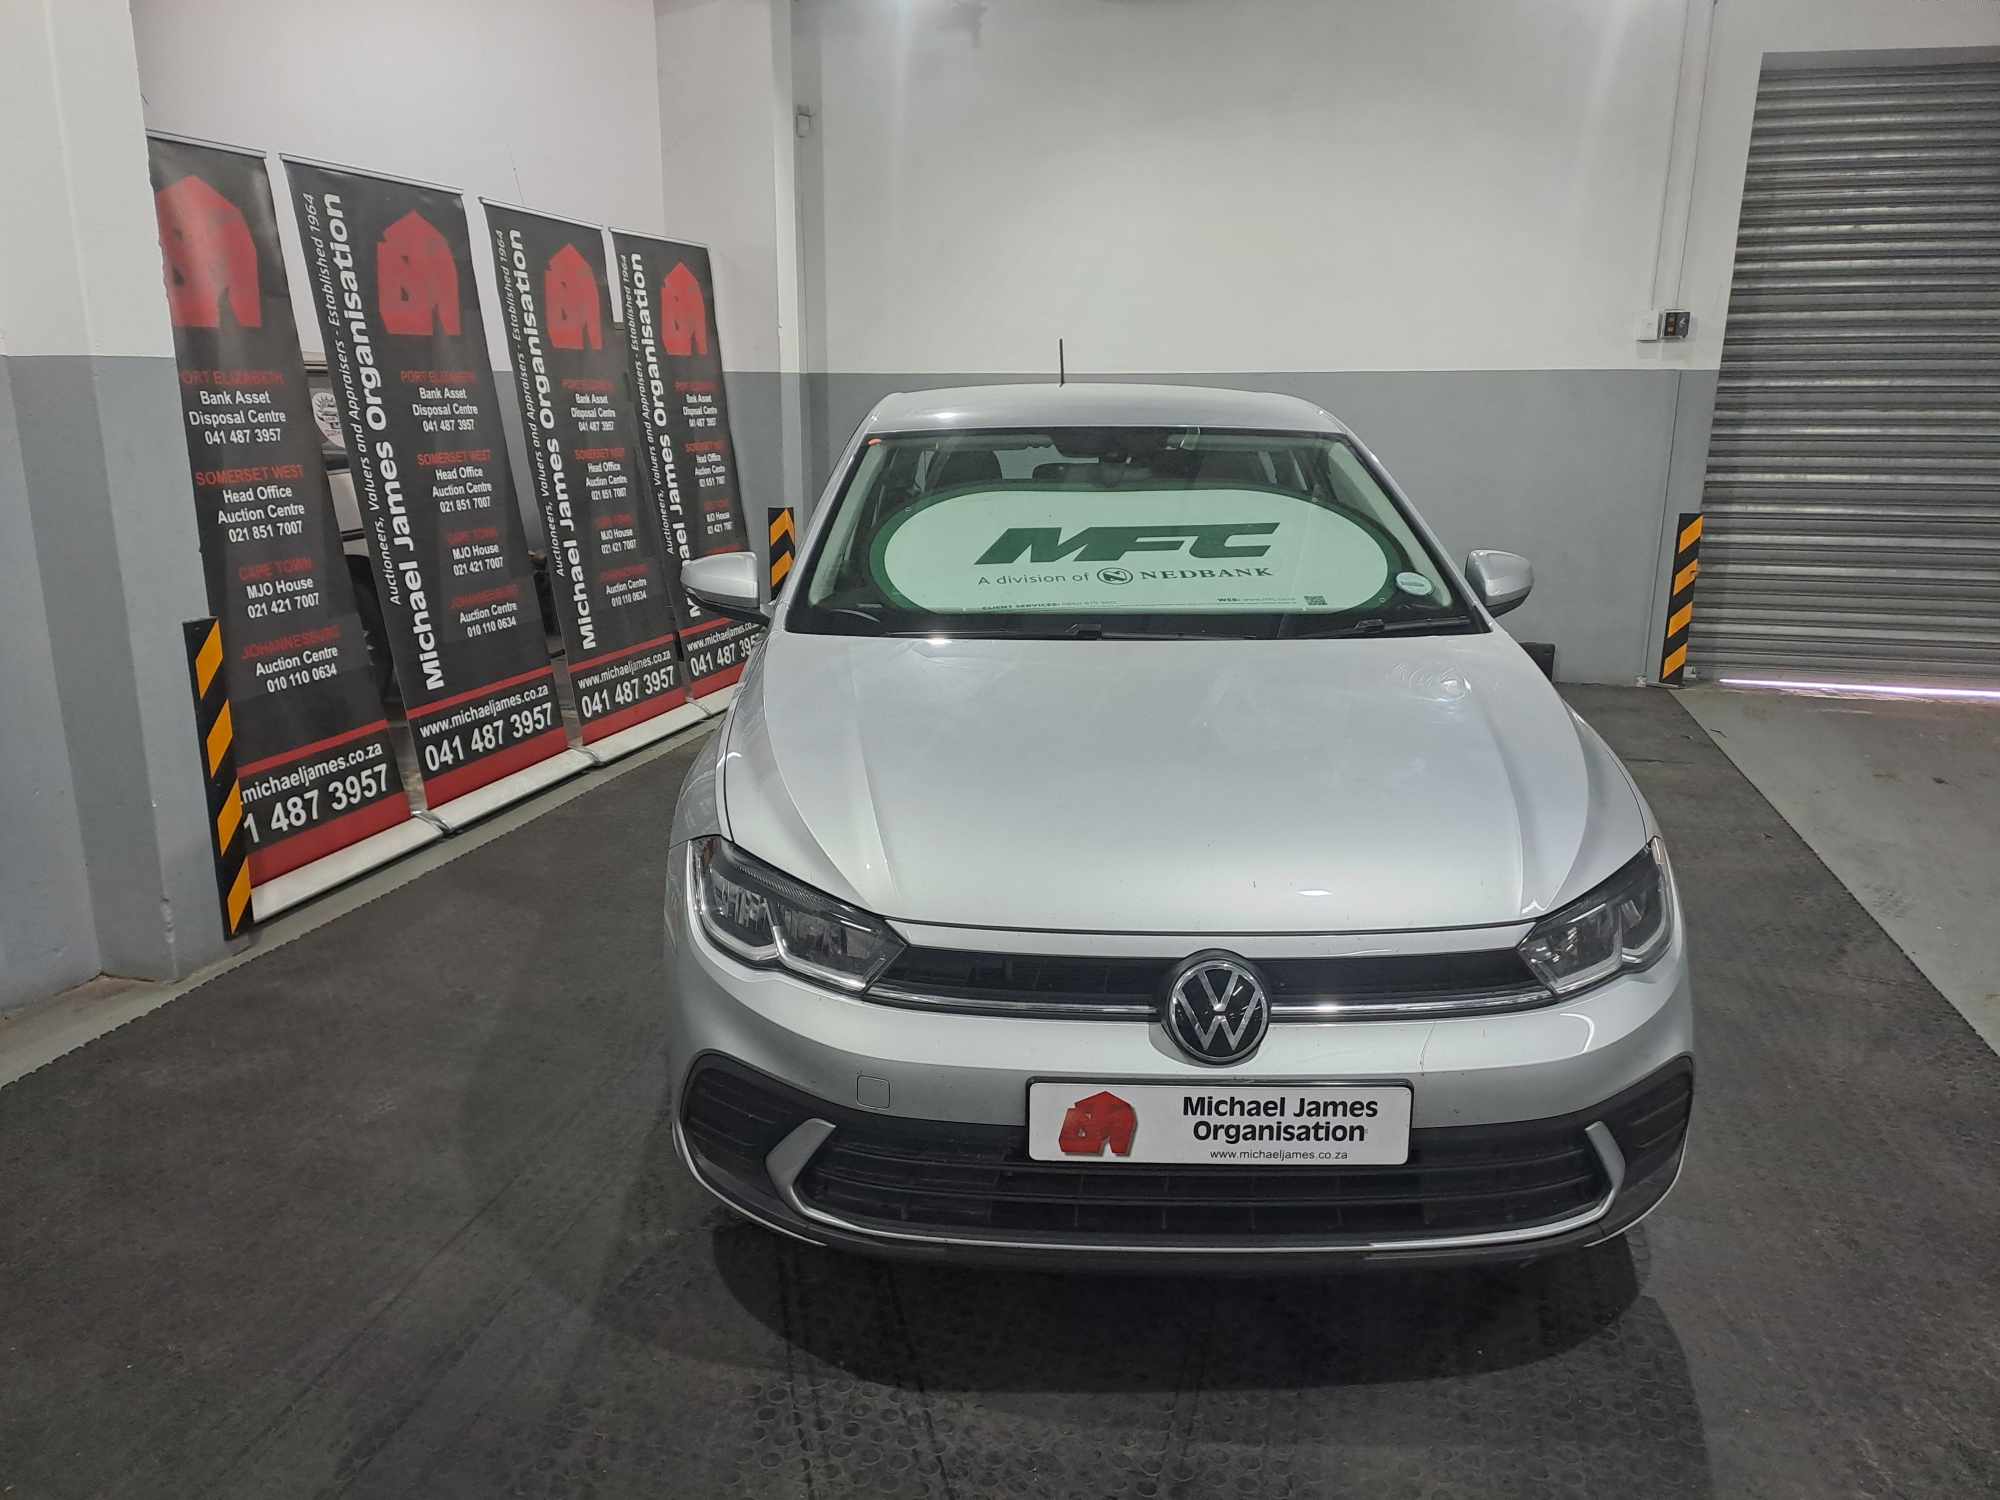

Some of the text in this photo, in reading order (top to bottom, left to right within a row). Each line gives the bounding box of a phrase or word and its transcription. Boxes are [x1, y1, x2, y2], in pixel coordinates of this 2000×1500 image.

[303, 193, 321, 232] 1964
[311, 236, 341, 326] Established
[324, 193, 387, 431] Organisation
[500, 265, 521, 341] Established
[630, 253, 667, 427] Organisation
[335, 340, 361, 420] Appraisers
[419, 387, 467, 399] Bank Asset
[517, 352, 536, 423] Appraisers
[200, 391, 271, 405] Bank Asset
[412, 403, 478, 418] Disposal Centre
[189, 410, 286, 427] Disposal Centre
[422, 420, 438, 432] 041
[440, 420, 455, 431] 487
[204, 428, 281, 445] 041 487 3957
[350, 423, 367, 452] and
[509, 229, 597, 650] Michael James Organisation
[528, 423, 540, 448] and
[195, 464, 304, 486] SOMERSET WEST
[361, 457, 380, 511] Valuers
[435, 466, 483, 480] Head Office
[535, 451, 549, 497] Valuers
[660, 434, 683, 515] James
[223, 485, 293, 504] Head Office
[375, 441, 414, 551] James
[432, 482, 492, 498] Auction Centre
[439, 501, 455, 513] 021
[472, 496, 491, 508] 7007
[217, 503, 305, 525] Auction Centre
[228, 520, 303, 543] 021 851 7007
[545, 502, 565, 577] Auctioneers,
[974, 522, 1280, 564] MFC
[375, 516, 401, 605] Auctioneers,
[452, 544, 499, 560] MJO House
[453, 557, 504, 576] 021 421 7007
[246, 577, 314, 600] MJO House
[977, 568, 1274, 585] A division of NEDBANK
[247, 592, 320, 619] 021 421 7007
[460, 602, 518, 623] Auction Centre
[399, 560, 445, 691] Michael
[467, 616, 517, 638] 010 110 0634
[687, 622, 753, 652] www.michaeljames.co
[255, 646, 339, 677] Auction Centre
[577, 649, 671, 690] www.michaeljames.co.za
[690, 652, 714, 677] 041
[716, 643, 735, 667] 487
[266, 663, 338, 693] 010 110 0634
[581, 665, 674, 718] 041 487 3957
[419, 684, 549, 738] www.michaeljames.co.za
[424, 702, 553, 771] 041 487 3957
[270, 789, 320, 832] 487
[328, 763, 388, 811] 3957
[1183, 1096, 1378, 1118] Michael James
[1193, 1120, 1365, 1144] Organisation
[1209, 1149, 1349, 1162] www.michaeljames.co.za
